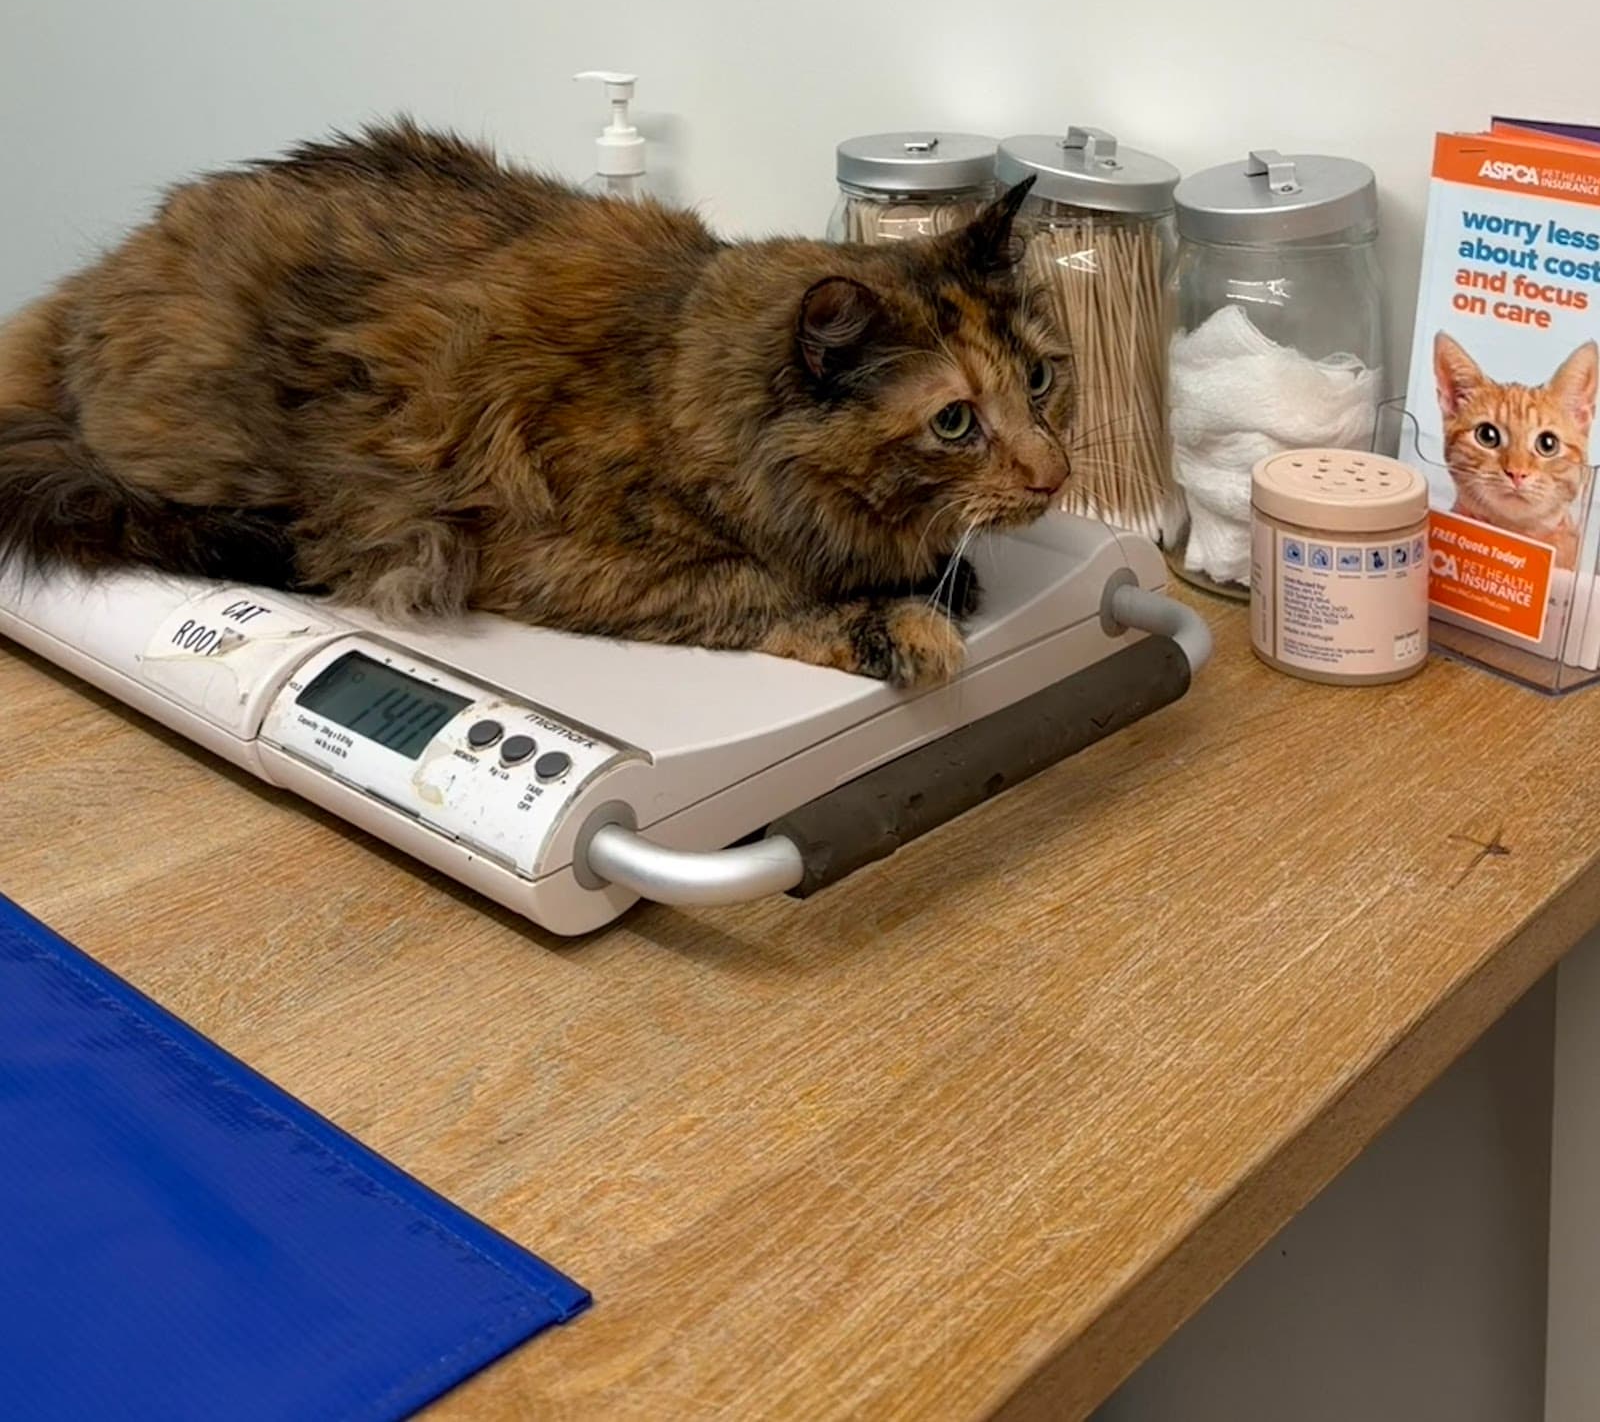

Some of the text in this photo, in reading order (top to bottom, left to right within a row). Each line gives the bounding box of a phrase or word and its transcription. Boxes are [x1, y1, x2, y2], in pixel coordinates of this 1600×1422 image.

[1478, 159, 1539, 186] ASPCA
[1541, 177, 1600, 196] INSURANCE
[1462, 210, 1600, 252] worry less
[1458, 237, 1539, 271] about
[1455, 267, 1588, 310] and focus
[1452, 292, 1552, 329] on care
[1432, 527, 1528, 569] FREE Quote Today!
[1460, 573, 1533, 608] INSURANCE
[1462, 559, 1534, 594] PET HEALTH
[222, 600, 272, 624] CAT
[517, 800, 531, 811] OFF
[524, 793, 535, 803] ON
